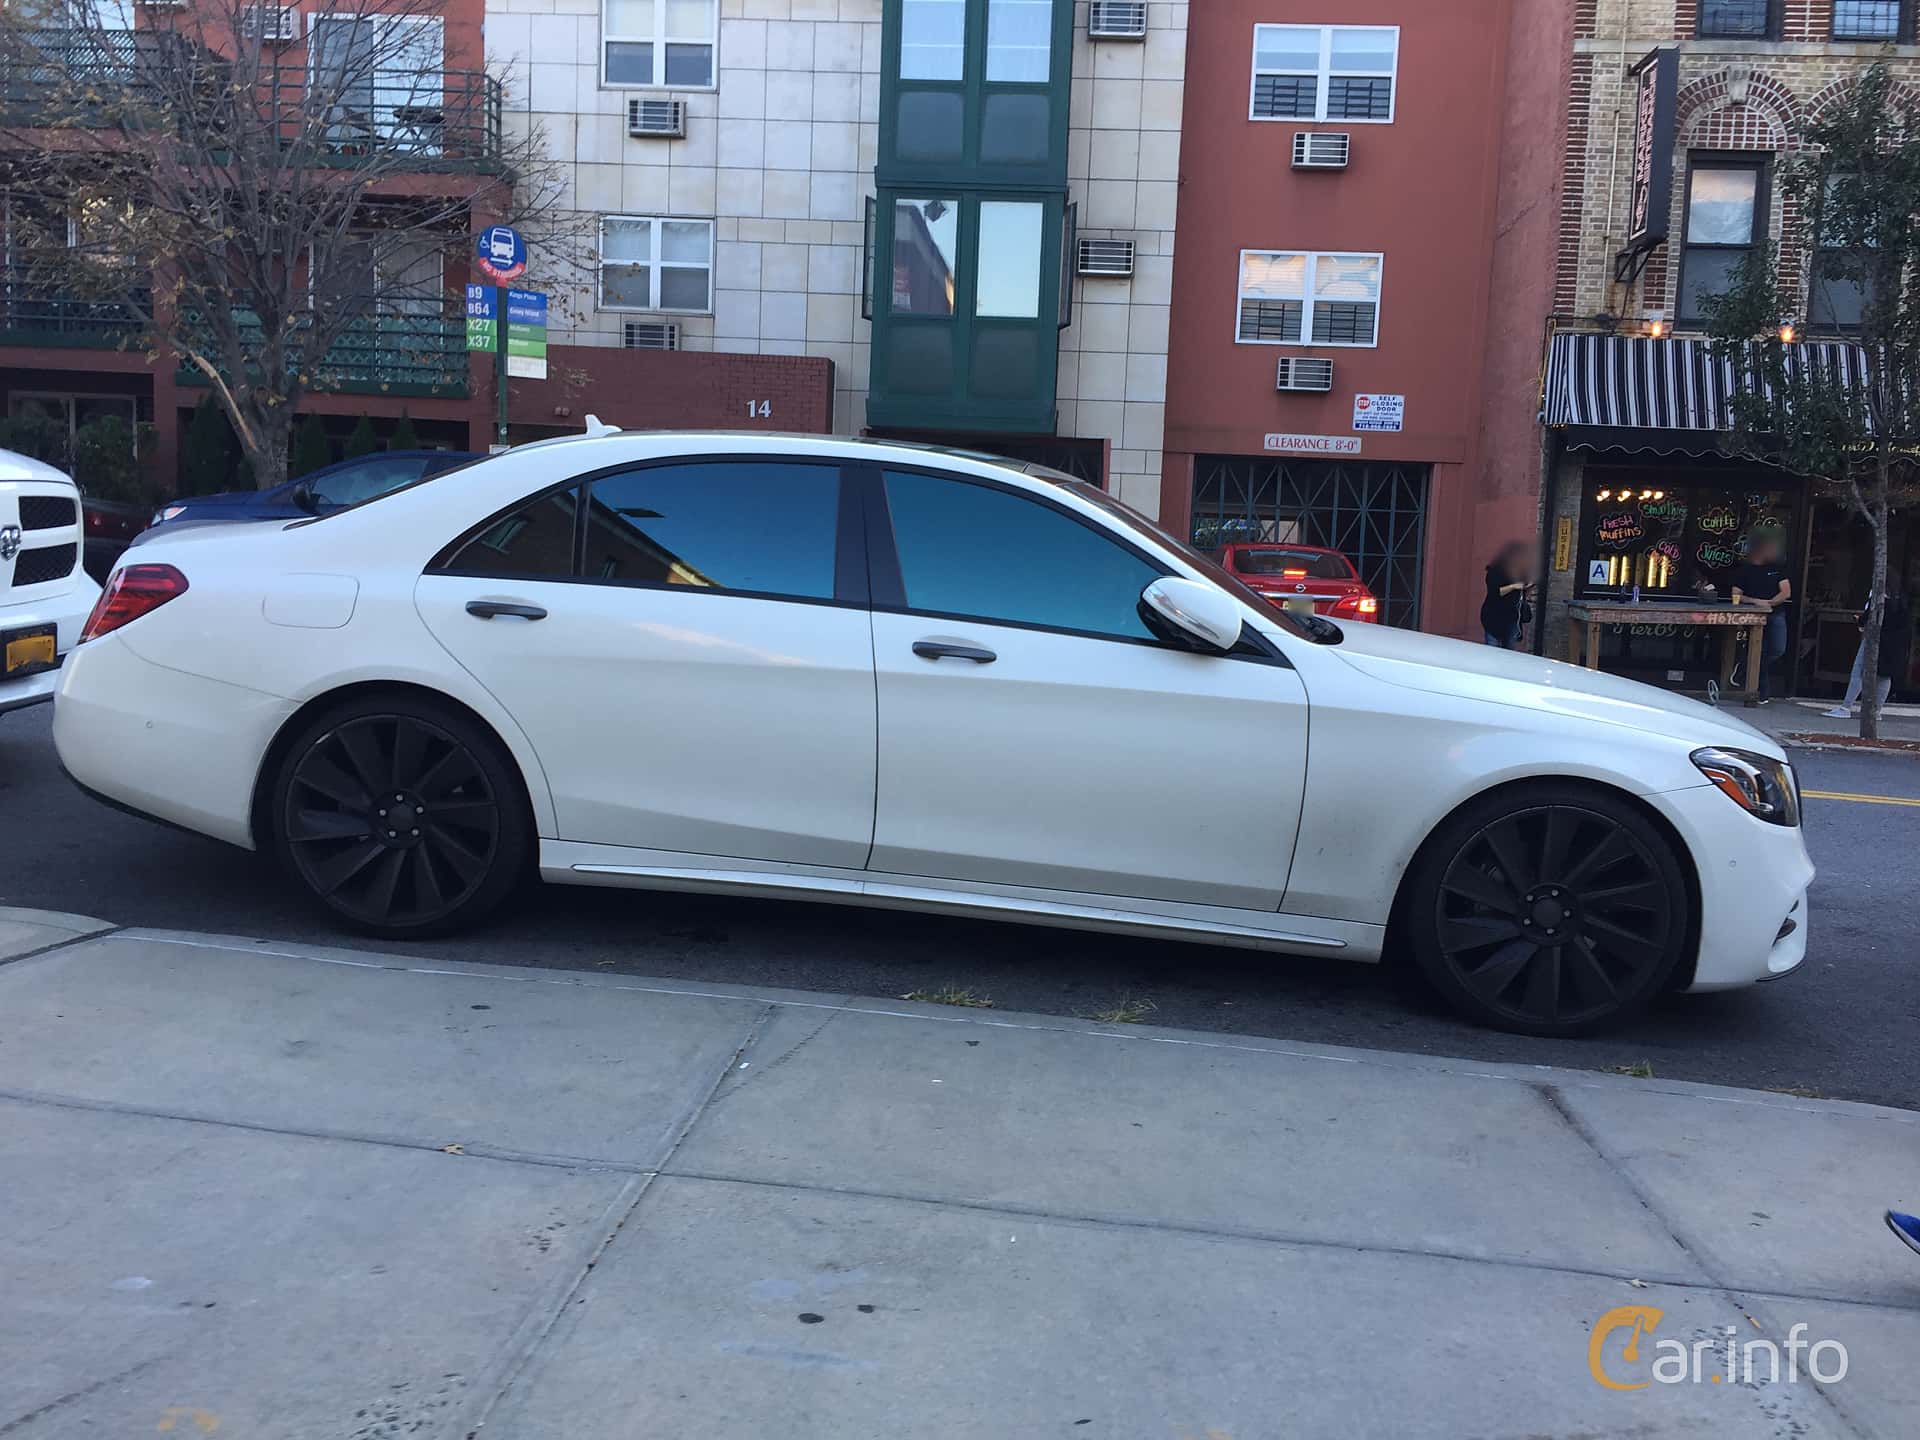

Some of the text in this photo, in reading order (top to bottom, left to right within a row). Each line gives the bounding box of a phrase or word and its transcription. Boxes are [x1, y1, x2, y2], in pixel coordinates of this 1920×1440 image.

[468, 286, 483, 299] B9
[468, 302, 490, 315] B64
[468, 318, 490, 332] X27
[468, 335, 490, 348] X37
[746, 399, 772, 418] 14
[1268, 435, 1330, 450] CLEARANCE
[1592, 562, 1605, 578] A
